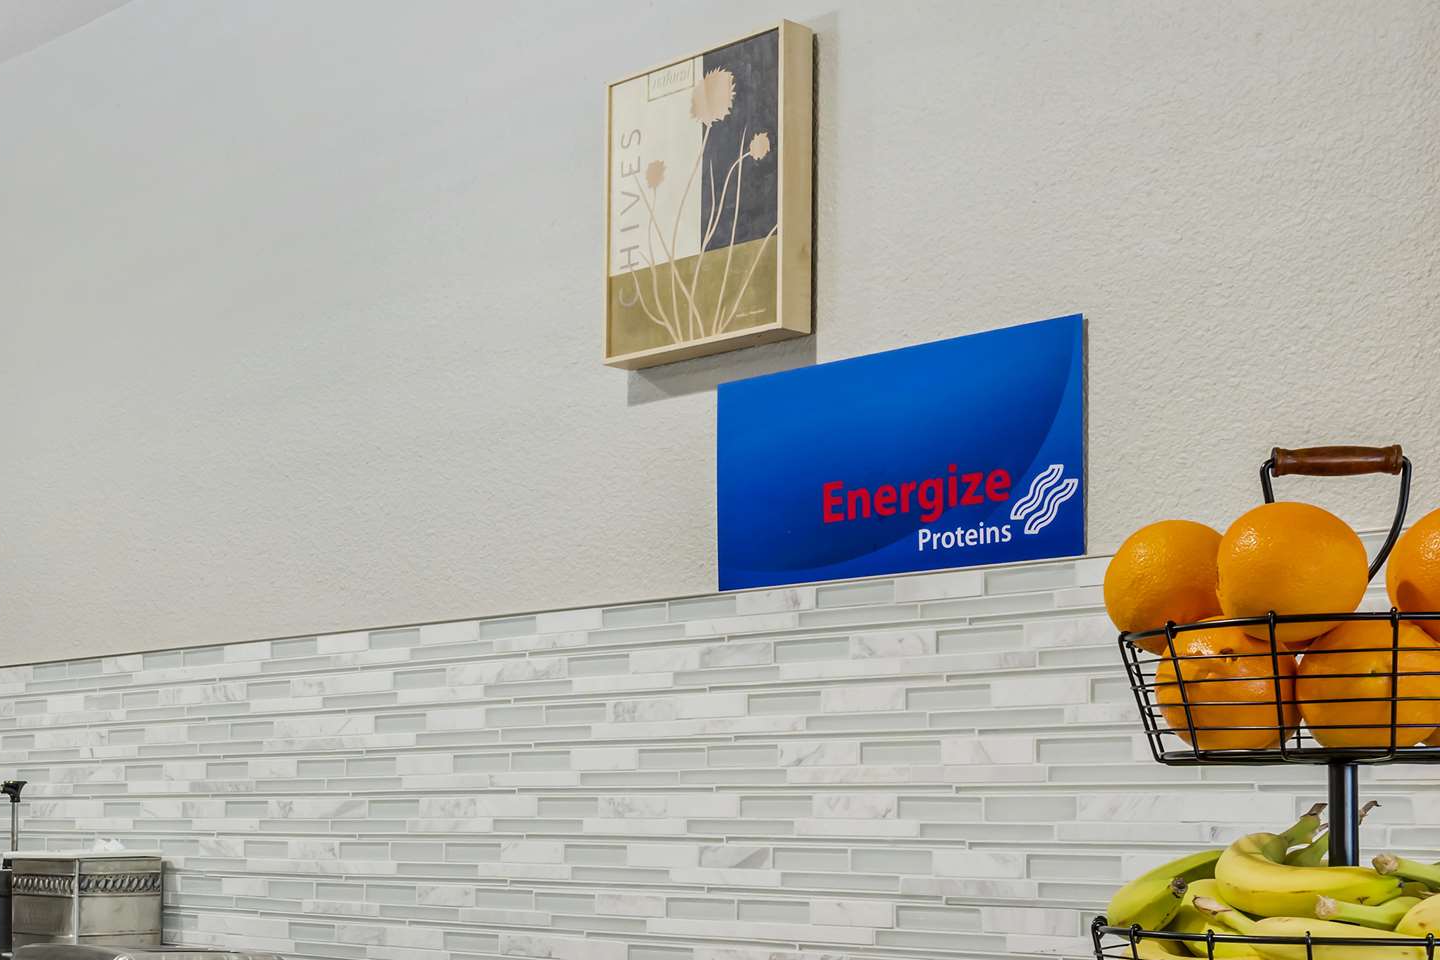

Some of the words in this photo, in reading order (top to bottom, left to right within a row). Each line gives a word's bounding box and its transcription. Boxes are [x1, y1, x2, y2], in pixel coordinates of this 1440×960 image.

[618, 128, 642, 308] CHIVES
[823, 464, 1012, 523] Energize
[918, 521, 1012, 551] Proteins
